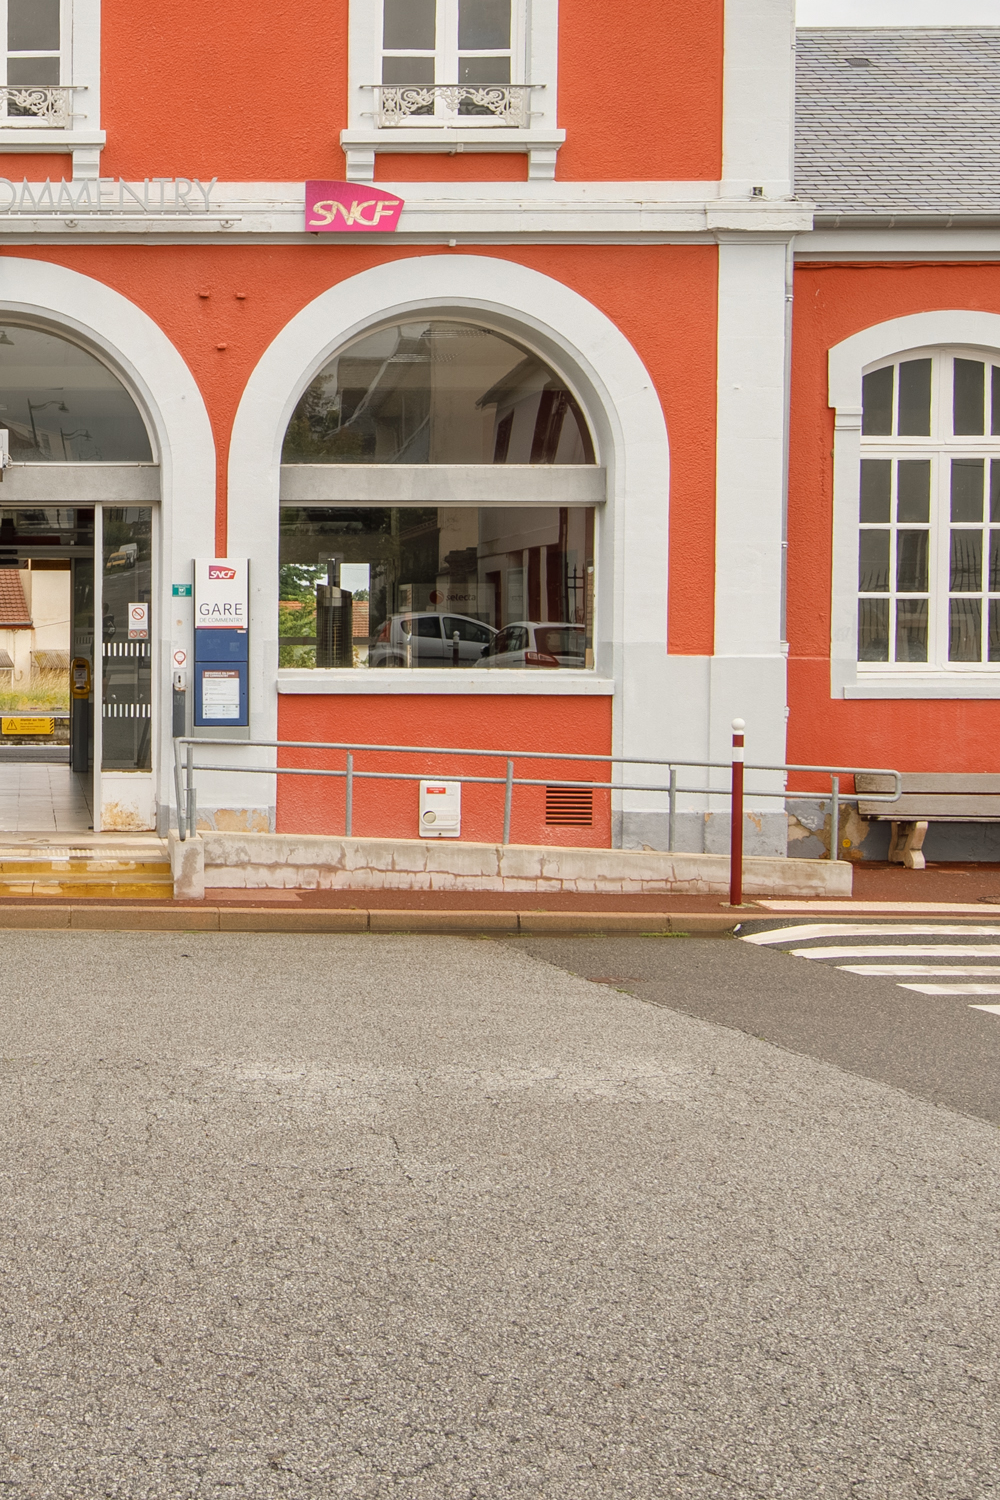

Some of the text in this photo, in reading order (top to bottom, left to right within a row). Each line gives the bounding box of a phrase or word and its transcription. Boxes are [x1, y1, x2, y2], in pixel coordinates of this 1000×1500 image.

[308, 200, 400, 226] SNCF
[209, 570, 235, 579] SNCF
[199, 603, 243, 616] GARE
